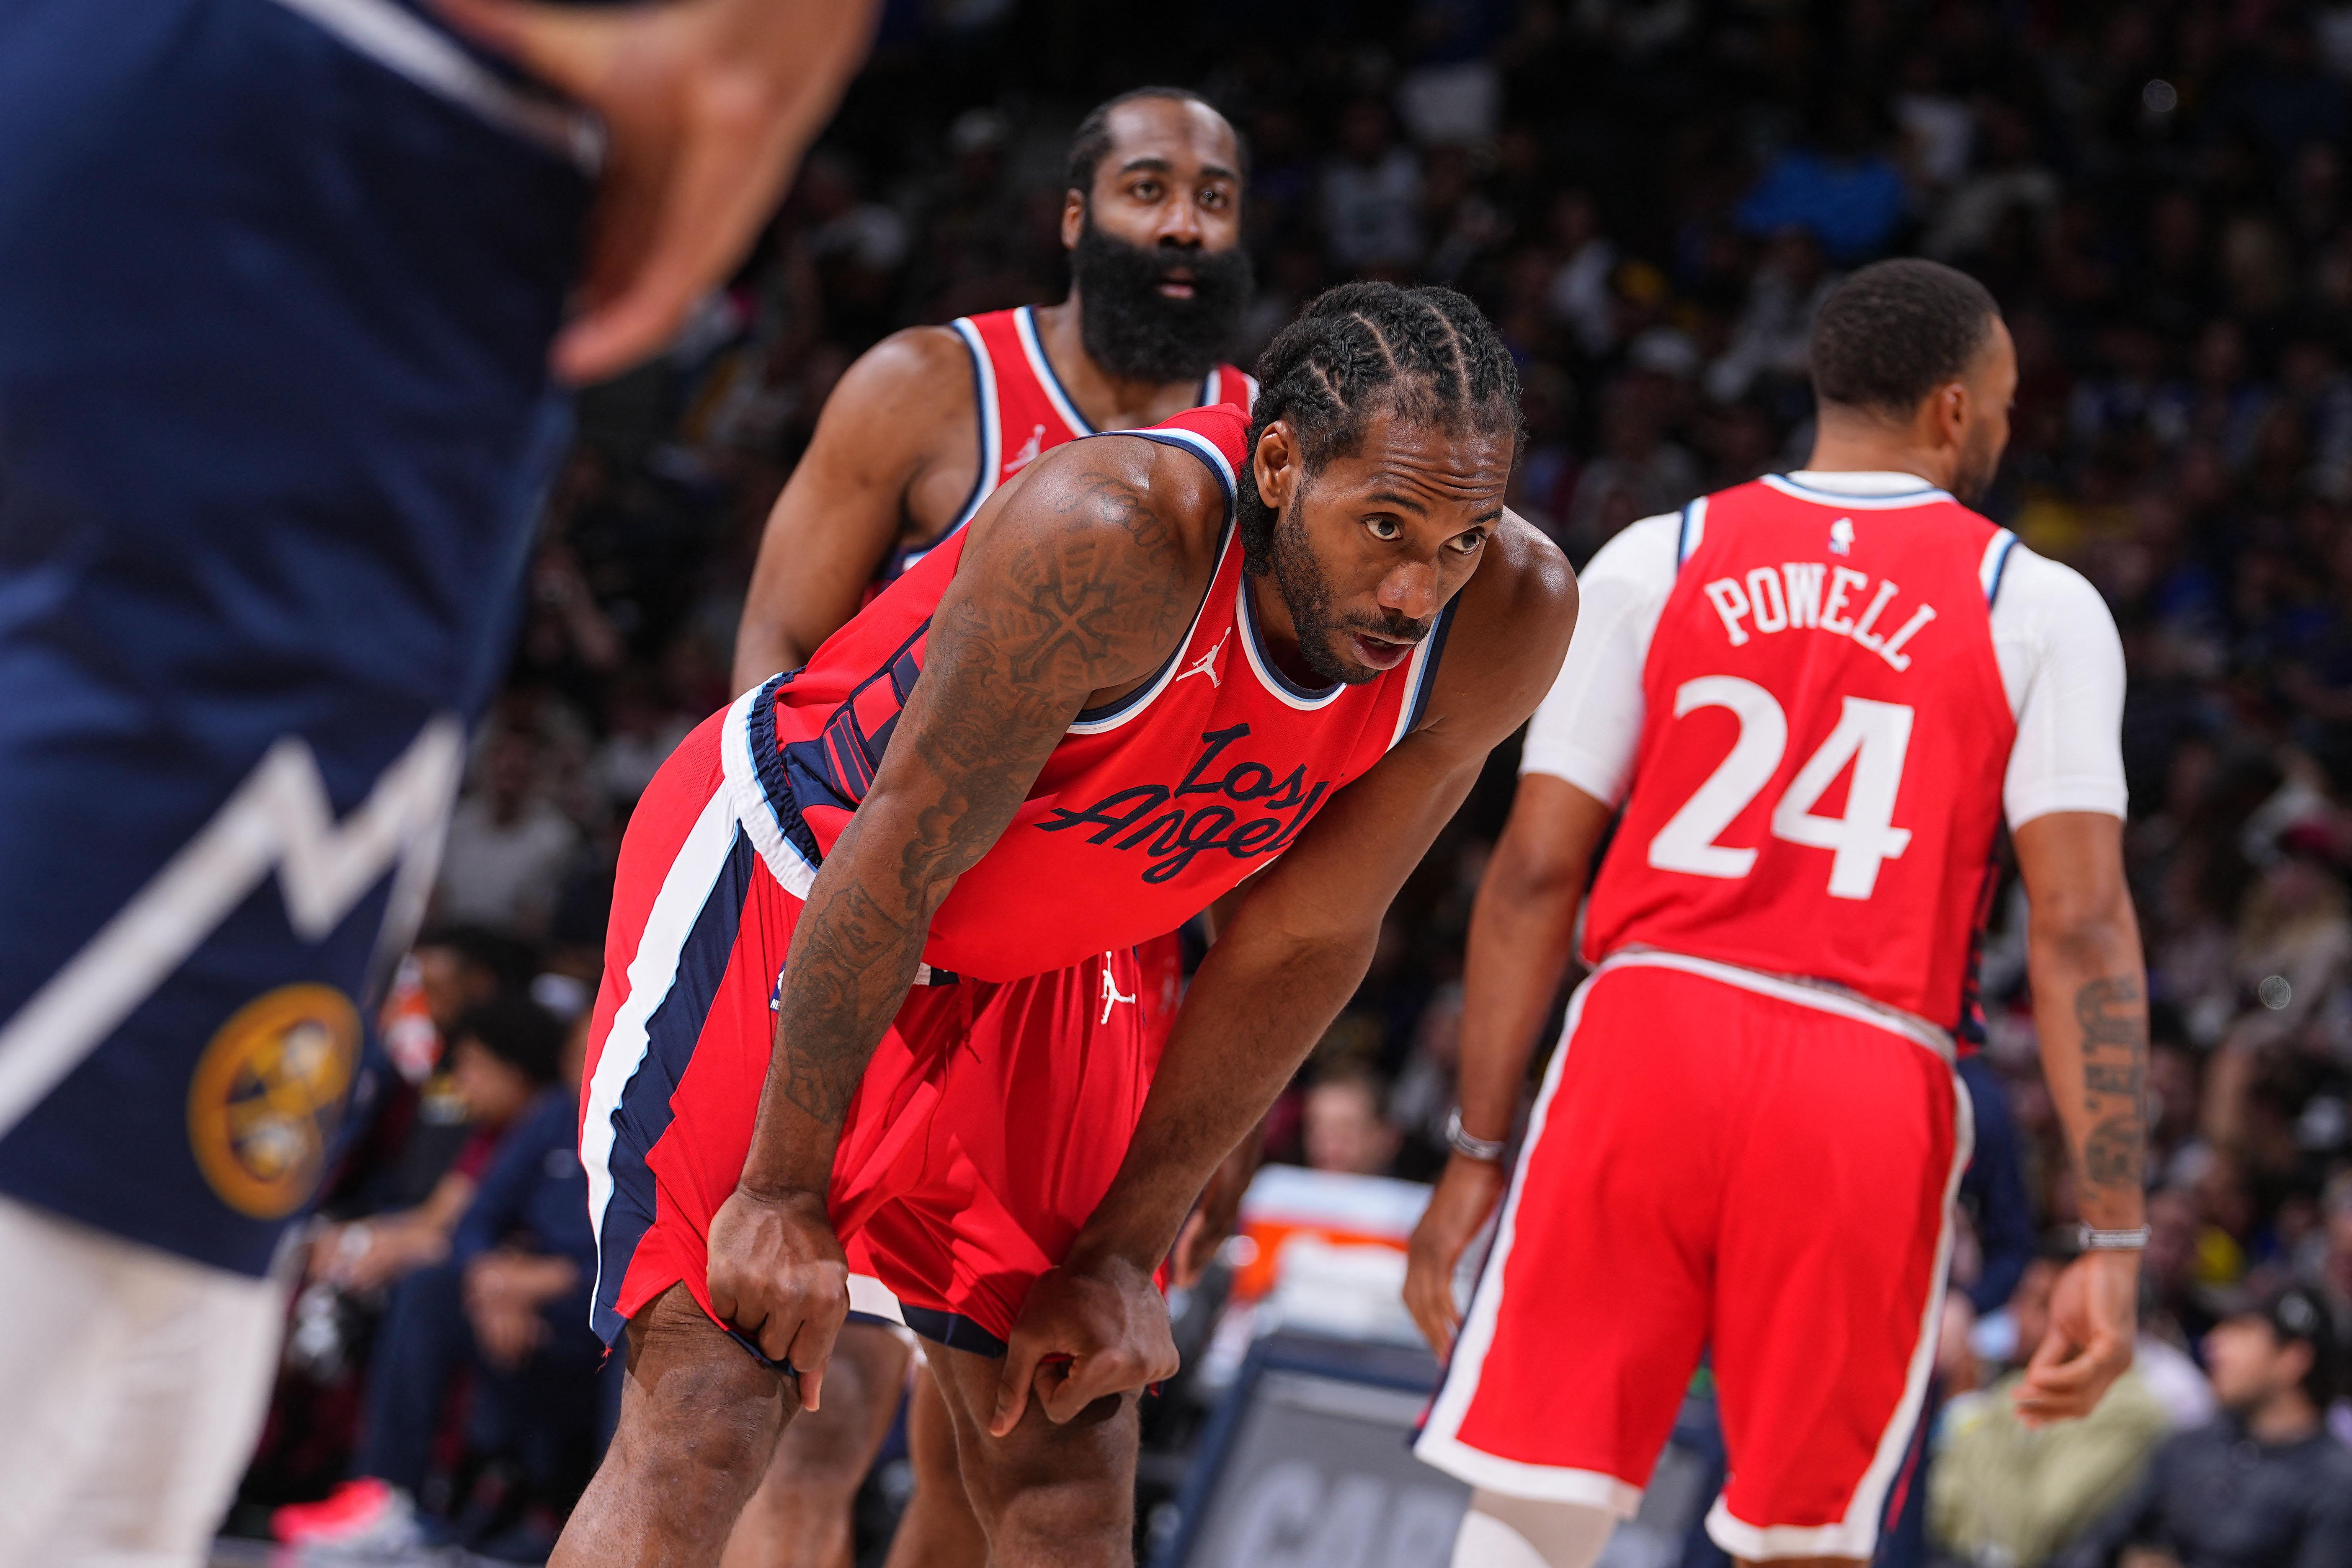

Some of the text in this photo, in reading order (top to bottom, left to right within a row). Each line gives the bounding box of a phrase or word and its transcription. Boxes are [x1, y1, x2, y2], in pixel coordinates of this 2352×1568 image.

[1704, 562, 1937, 673] POWELL
[1173, 722, 1308, 809] Los
[1646, 674, 1915, 900] 24
[1032, 781, 1330, 884] Angel
